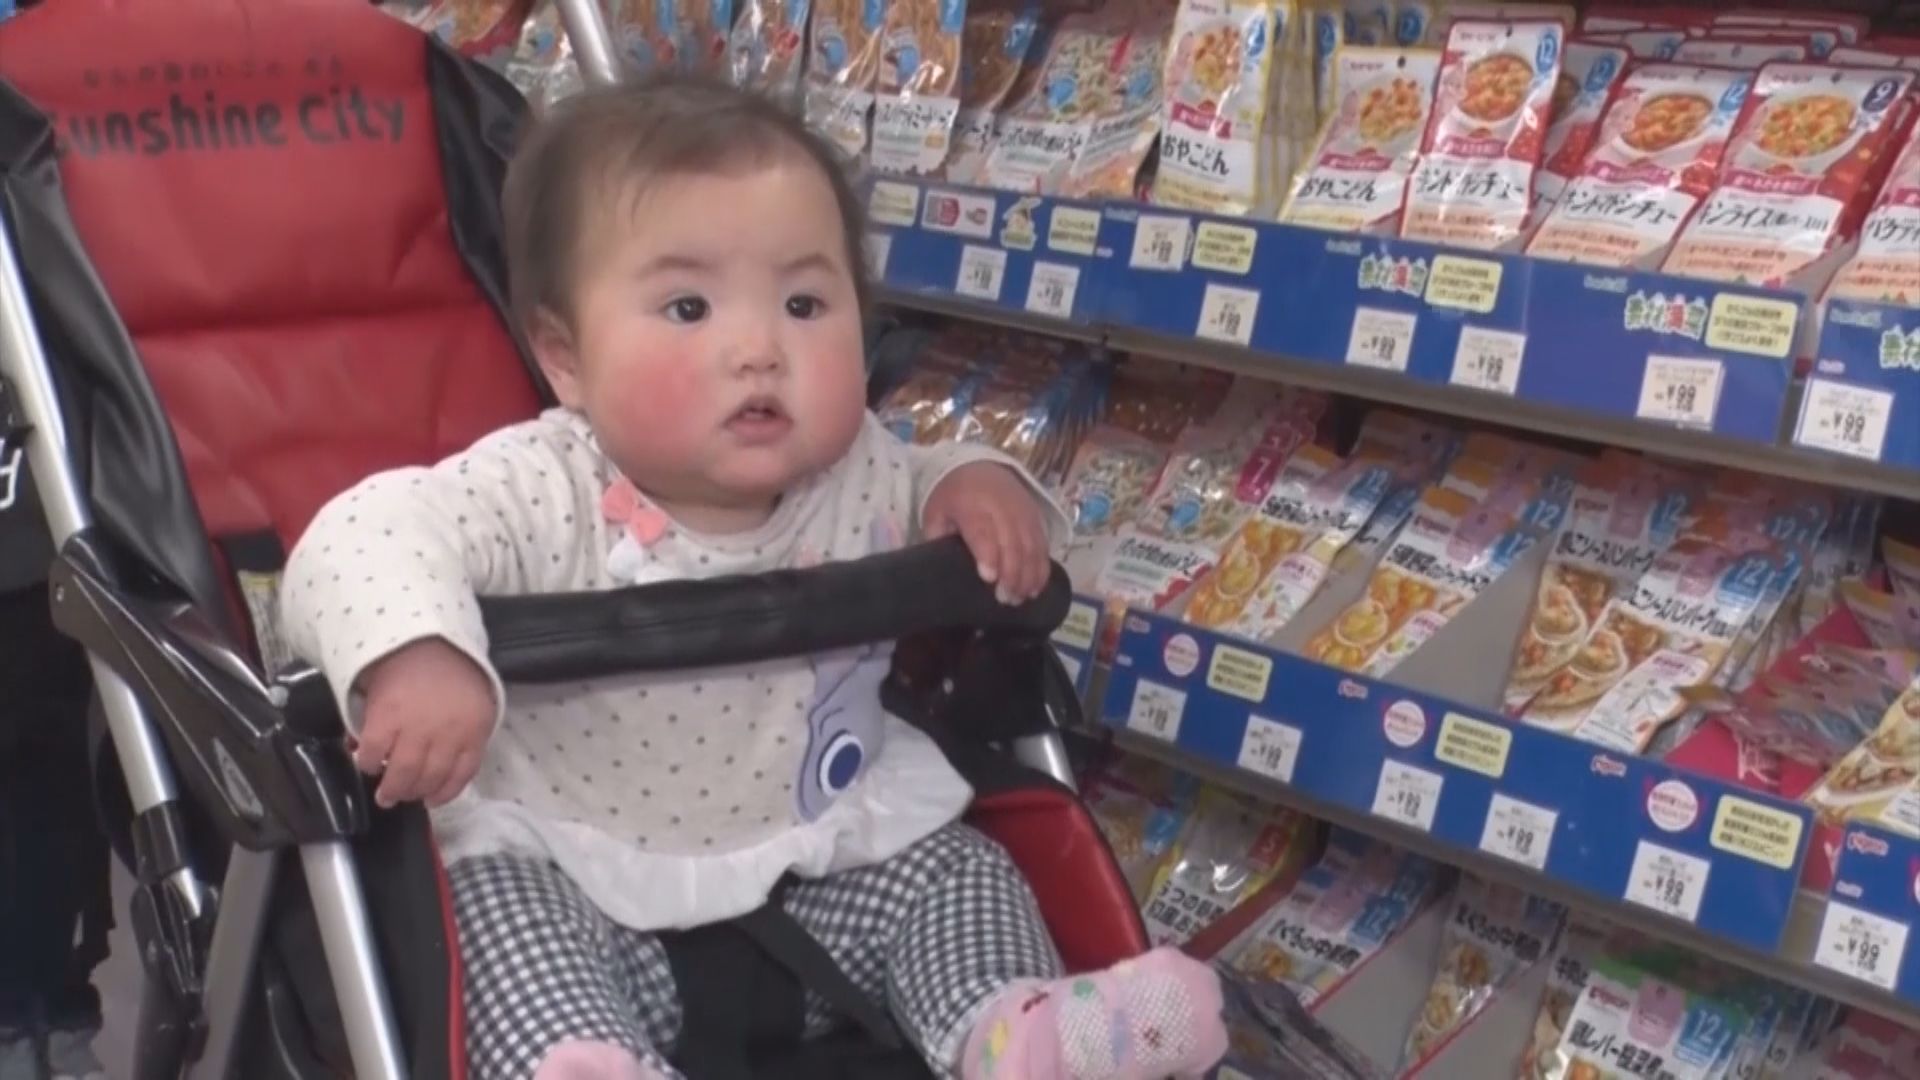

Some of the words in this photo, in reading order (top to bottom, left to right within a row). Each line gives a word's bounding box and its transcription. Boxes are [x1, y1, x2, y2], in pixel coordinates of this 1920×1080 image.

[1876, 82, 1894, 102] 9
[1162, 133, 1230, 176] おやこどん
[1299, 177, 1377, 203] おやこどん
[1667, 383, 1697, 402] ¥99
[1833, 411, 1866, 431] ¥99
[1251, 456, 1271, 486] 7
[1531, 499, 1560, 528] 12
[1664, 495, 1687, 521] 12
[1743, 557, 1769, 588] 12
[1655, 876, 1684, 898] ¥99
[1847, 940, 1881, 961] ¥99
[1695, 1009, 1722, 1042] 12
